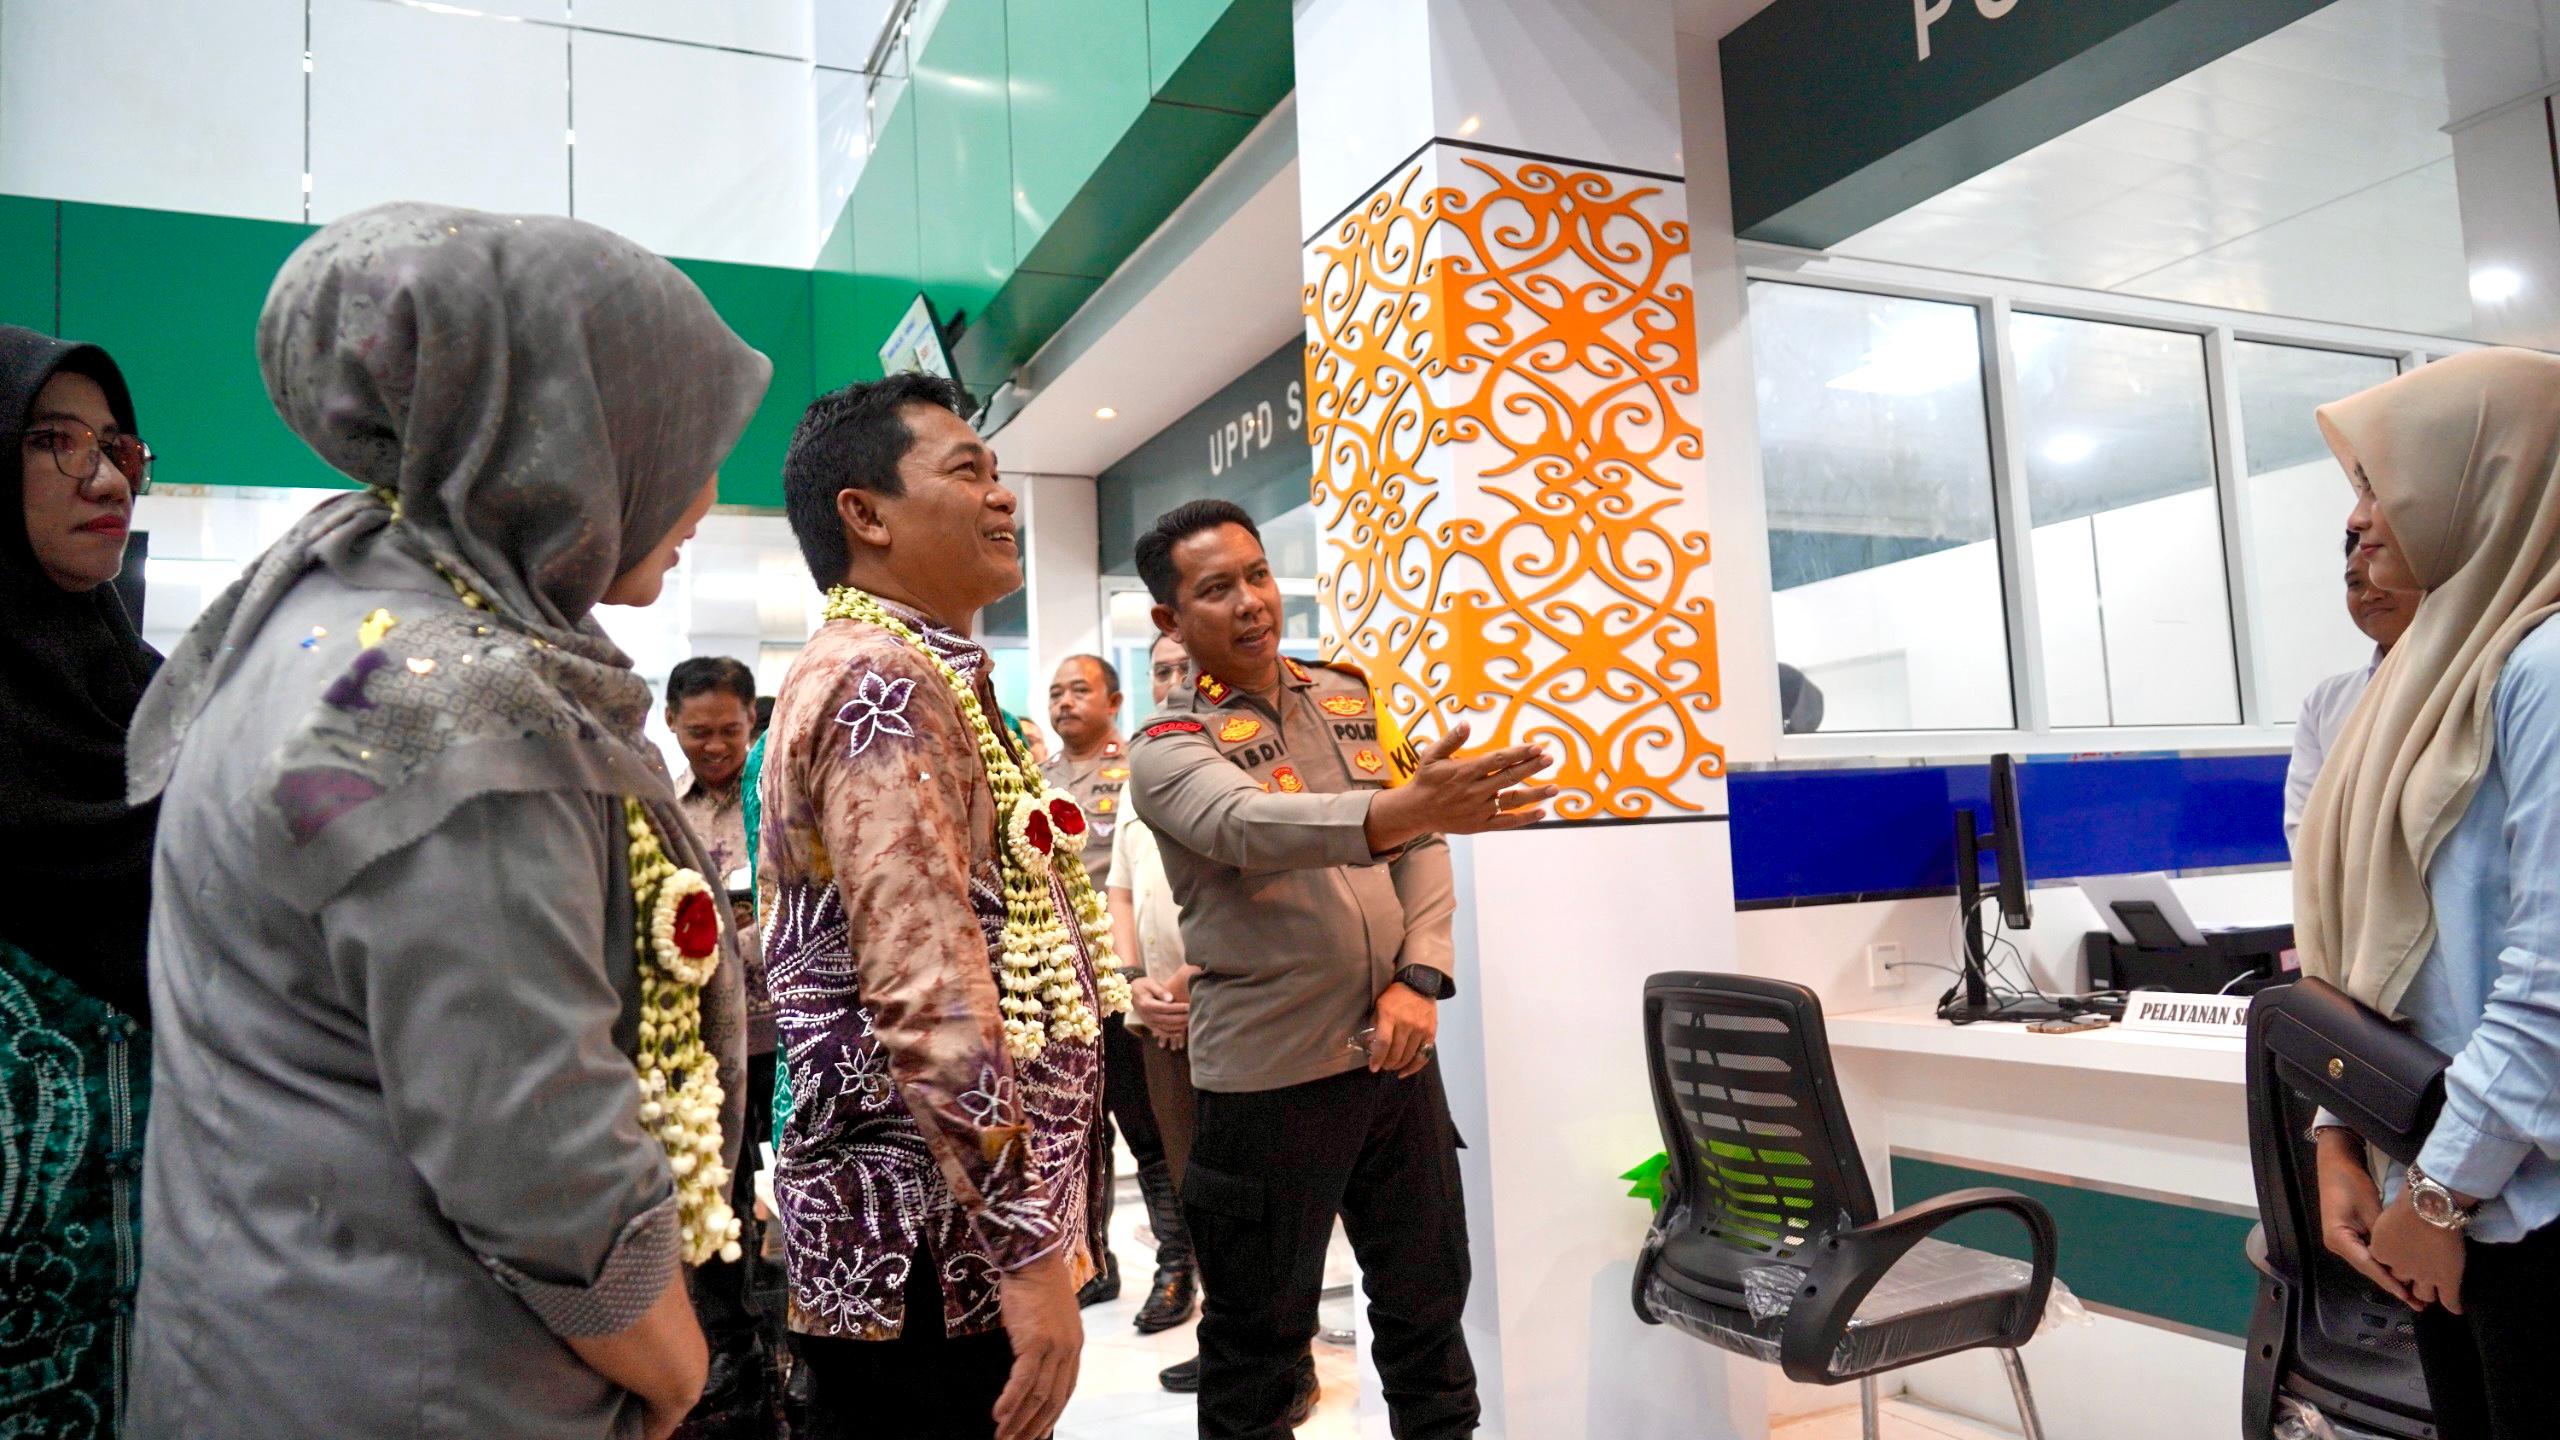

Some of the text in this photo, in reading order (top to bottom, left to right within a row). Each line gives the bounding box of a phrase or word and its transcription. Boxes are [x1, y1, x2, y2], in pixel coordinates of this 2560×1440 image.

[1913, 0, 2018, 61] P
[1209, 400, 1273, 476] UPPD
[2139, 1002, 2231, 1025] PELAYANAN
